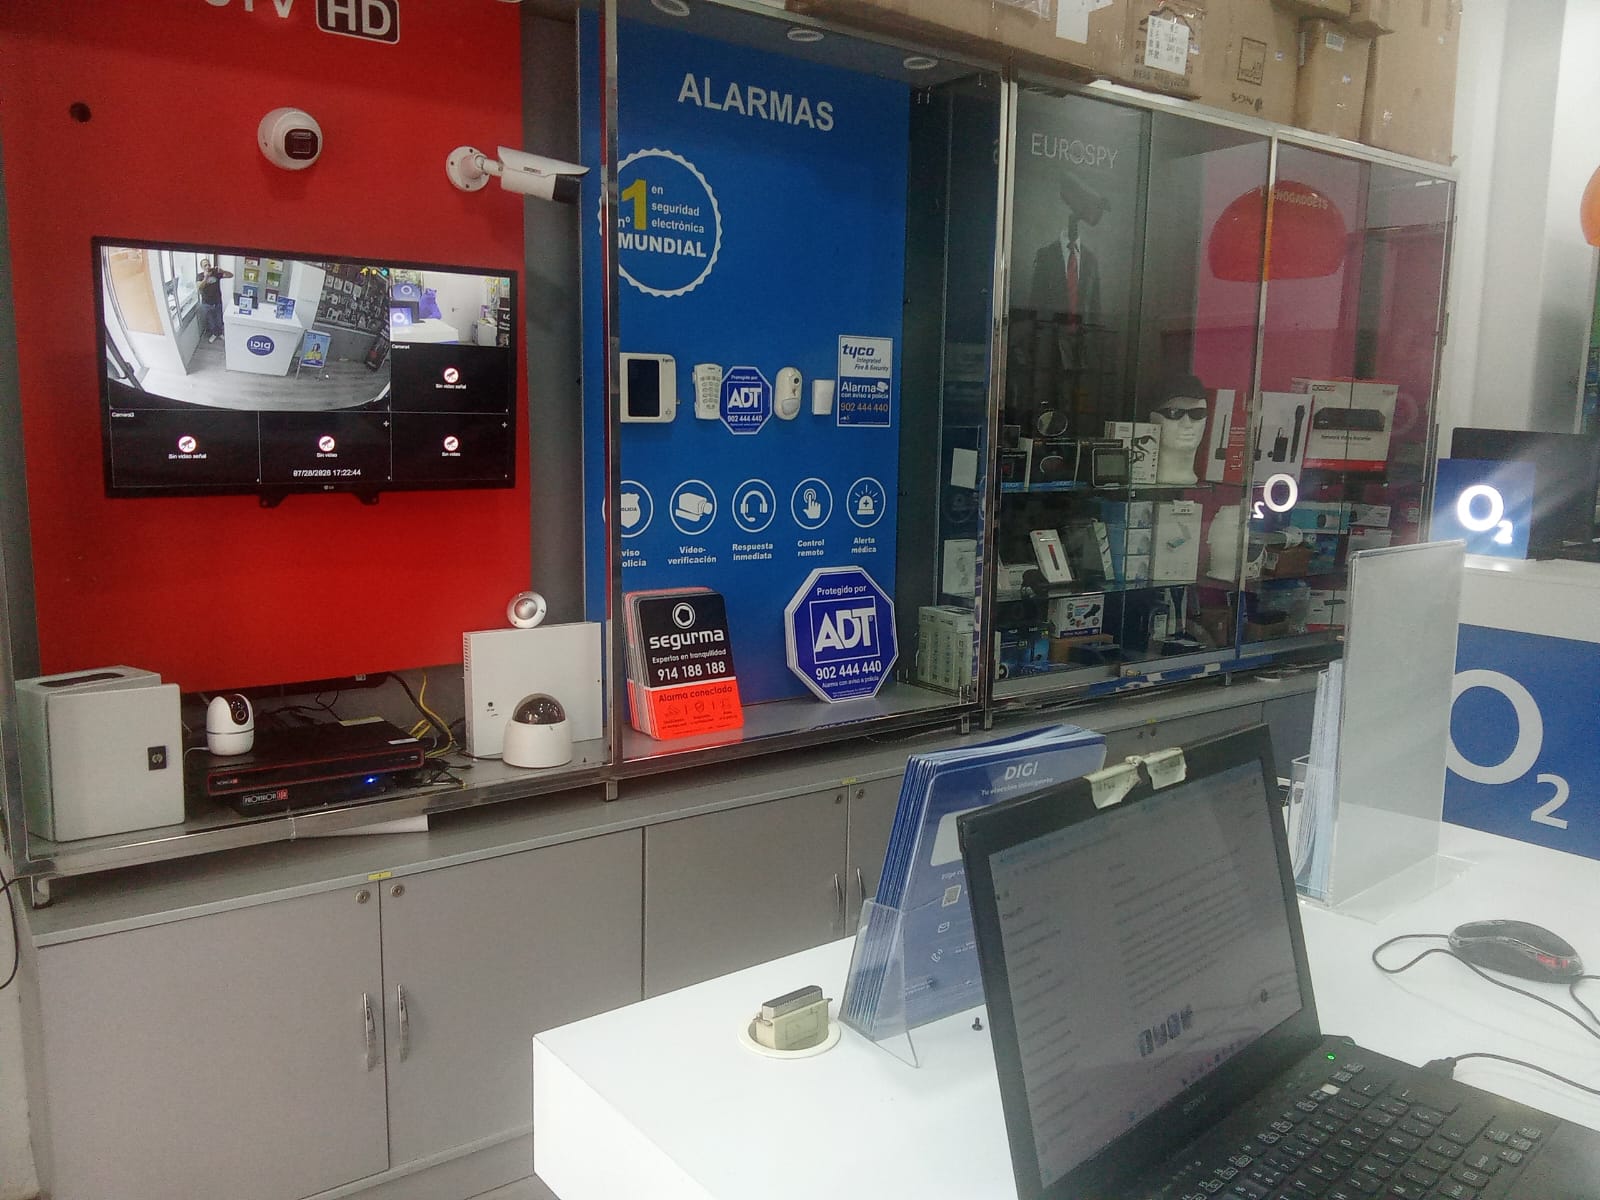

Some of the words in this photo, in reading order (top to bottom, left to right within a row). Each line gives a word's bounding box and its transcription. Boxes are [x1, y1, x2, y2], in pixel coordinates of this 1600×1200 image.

[327, 0, 391, 36] HD
[677, 72, 834, 131] ALARMAS
[1031, 132, 1119, 168] EUROSPY
[651, 185, 663, 195] en
[621, 178, 647, 231] 1
[651, 202, 700, 217] seguridad
[651, 217, 705, 234] electrónica
[618, 231, 707, 258] MUNDIAL
[842, 344, 875, 359] tyco
[841, 382, 876, 392] Alarma
[727, 387, 762, 409] ADT
[840, 402, 856, 411] 902
[856, 403, 872, 412] 444
[873, 403, 889, 412] 440
[1456, 484, 1513, 545] O2
[732, 542, 773, 551] Respuesta
[797, 539, 825, 547] Control
[621, 549, 640, 557] viso
[667, 555, 717, 565] verificación
[797, 549, 824, 557] remoto
[621, 558, 647, 568] olicía
[816, 586, 853, 596] Protegido
[854, 585, 867, 594] por
[815, 607, 876, 653] ADT
[649, 629, 725, 651] segurma
[652, 655, 680, 664] Expertos
[689, 648, 727, 659] tranquilidad
[657, 666, 678, 680] 914
[682, 663, 702, 678] 188
[705, 661, 726, 675] 188
[816, 666, 836, 680] 902
[839, 663, 860, 677] 444
[862, 660, 882, 674] 440
[658, 692, 688, 703] Alarma
[1446, 668, 1570, 830] O2
[1004, 761, 1039, 780] DIGI
